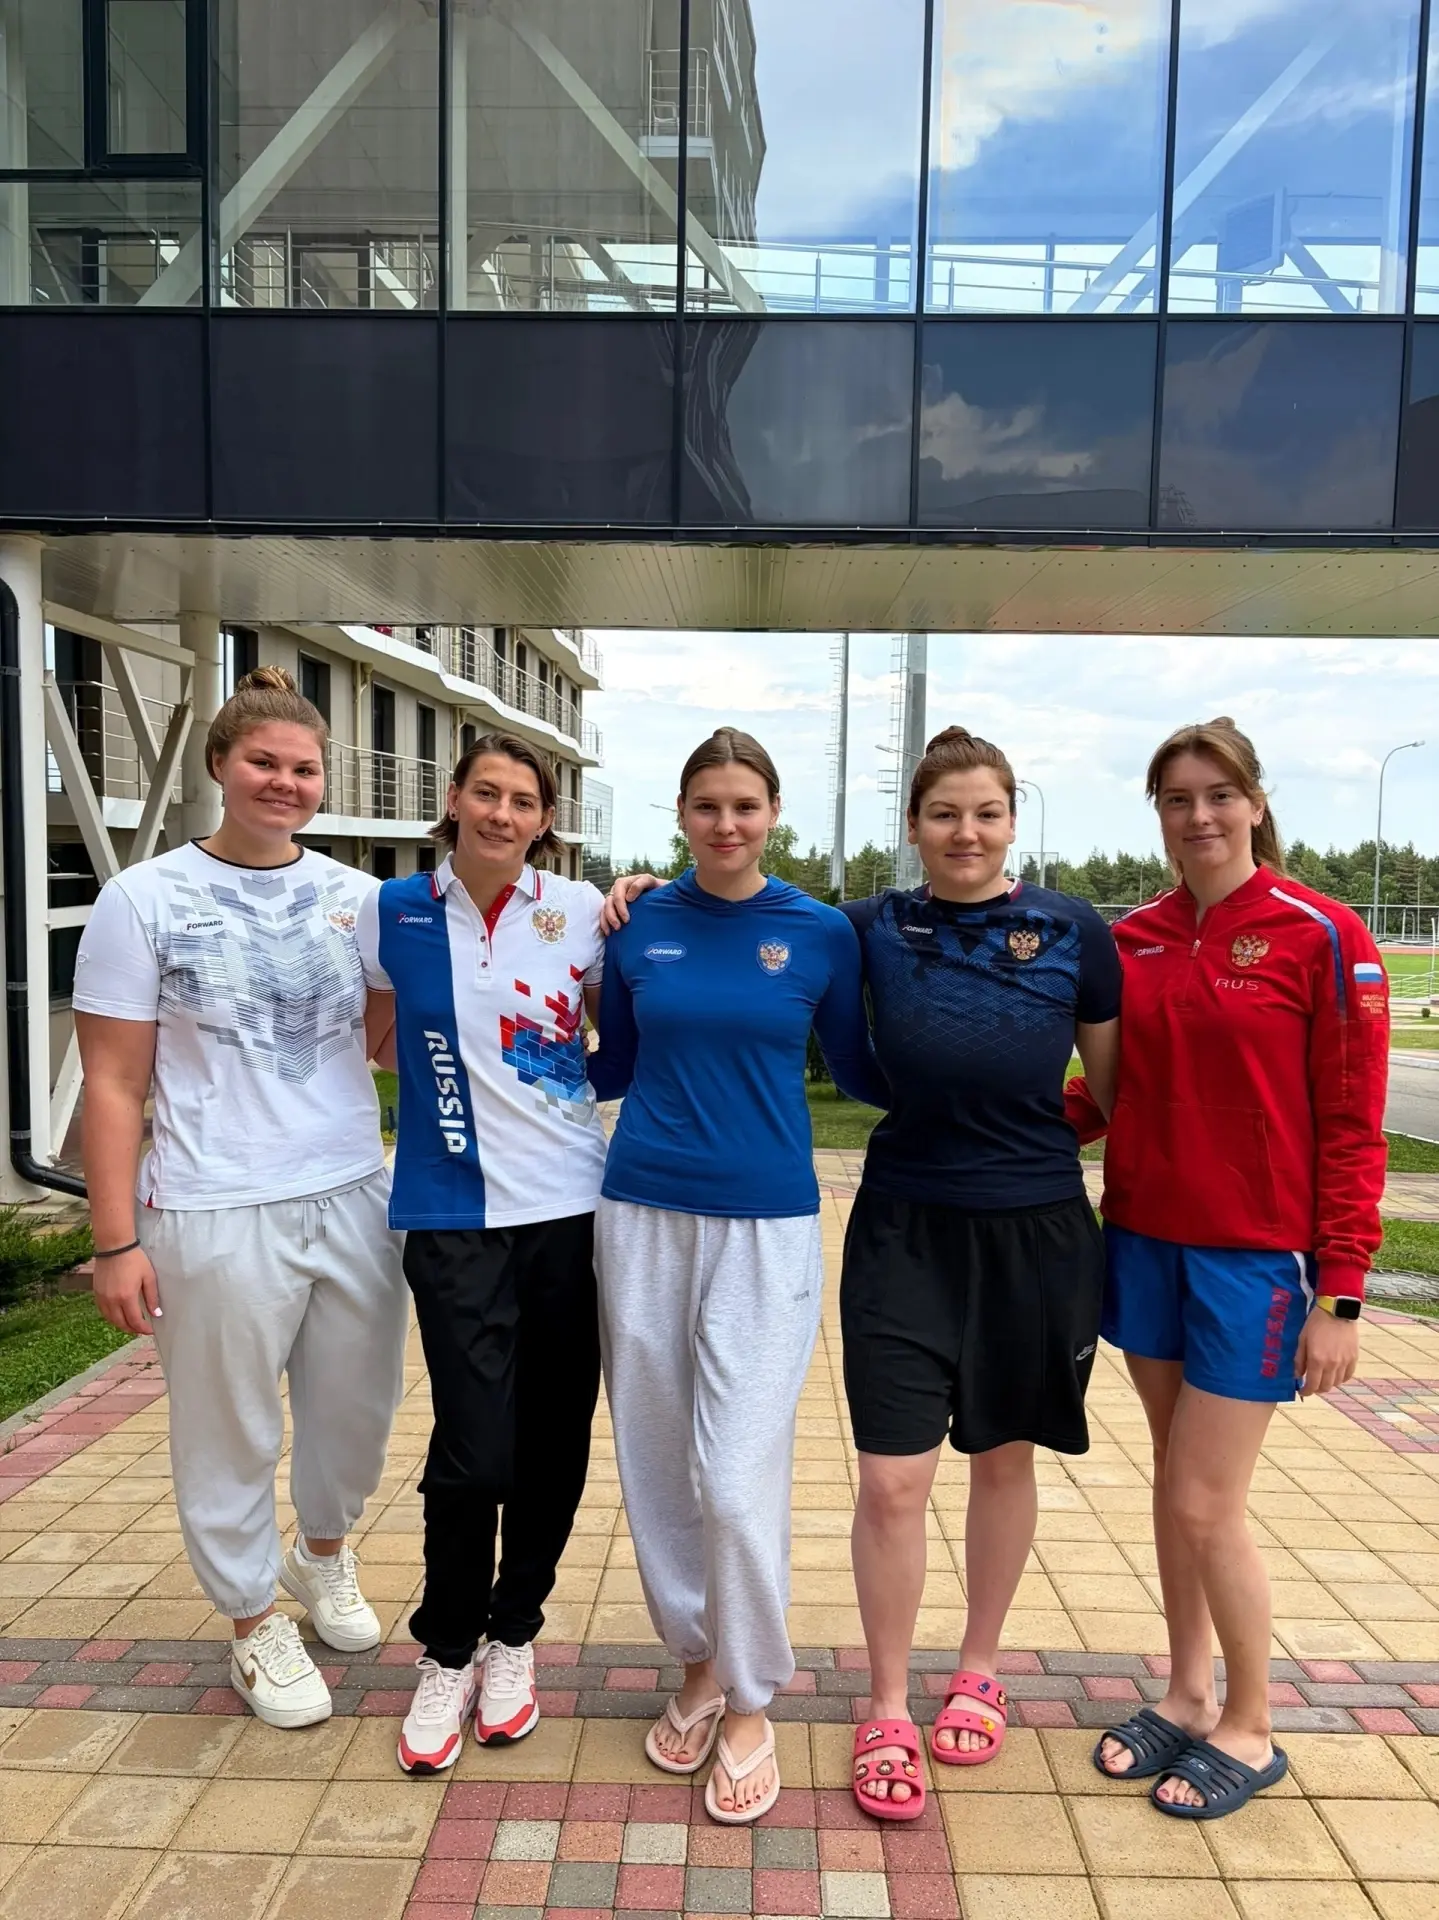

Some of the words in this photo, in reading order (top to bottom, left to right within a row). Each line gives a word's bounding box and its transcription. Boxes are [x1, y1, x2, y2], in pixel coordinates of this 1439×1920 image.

[398, 912, 433, 924] FORWARD
[186, 920, 223, 931] FORWARD
[647, 947, 682, 955] FORWARD
[1215, 978, 1259, 991] RUS
[423, 1030, 467, 1154] RUSSIA
